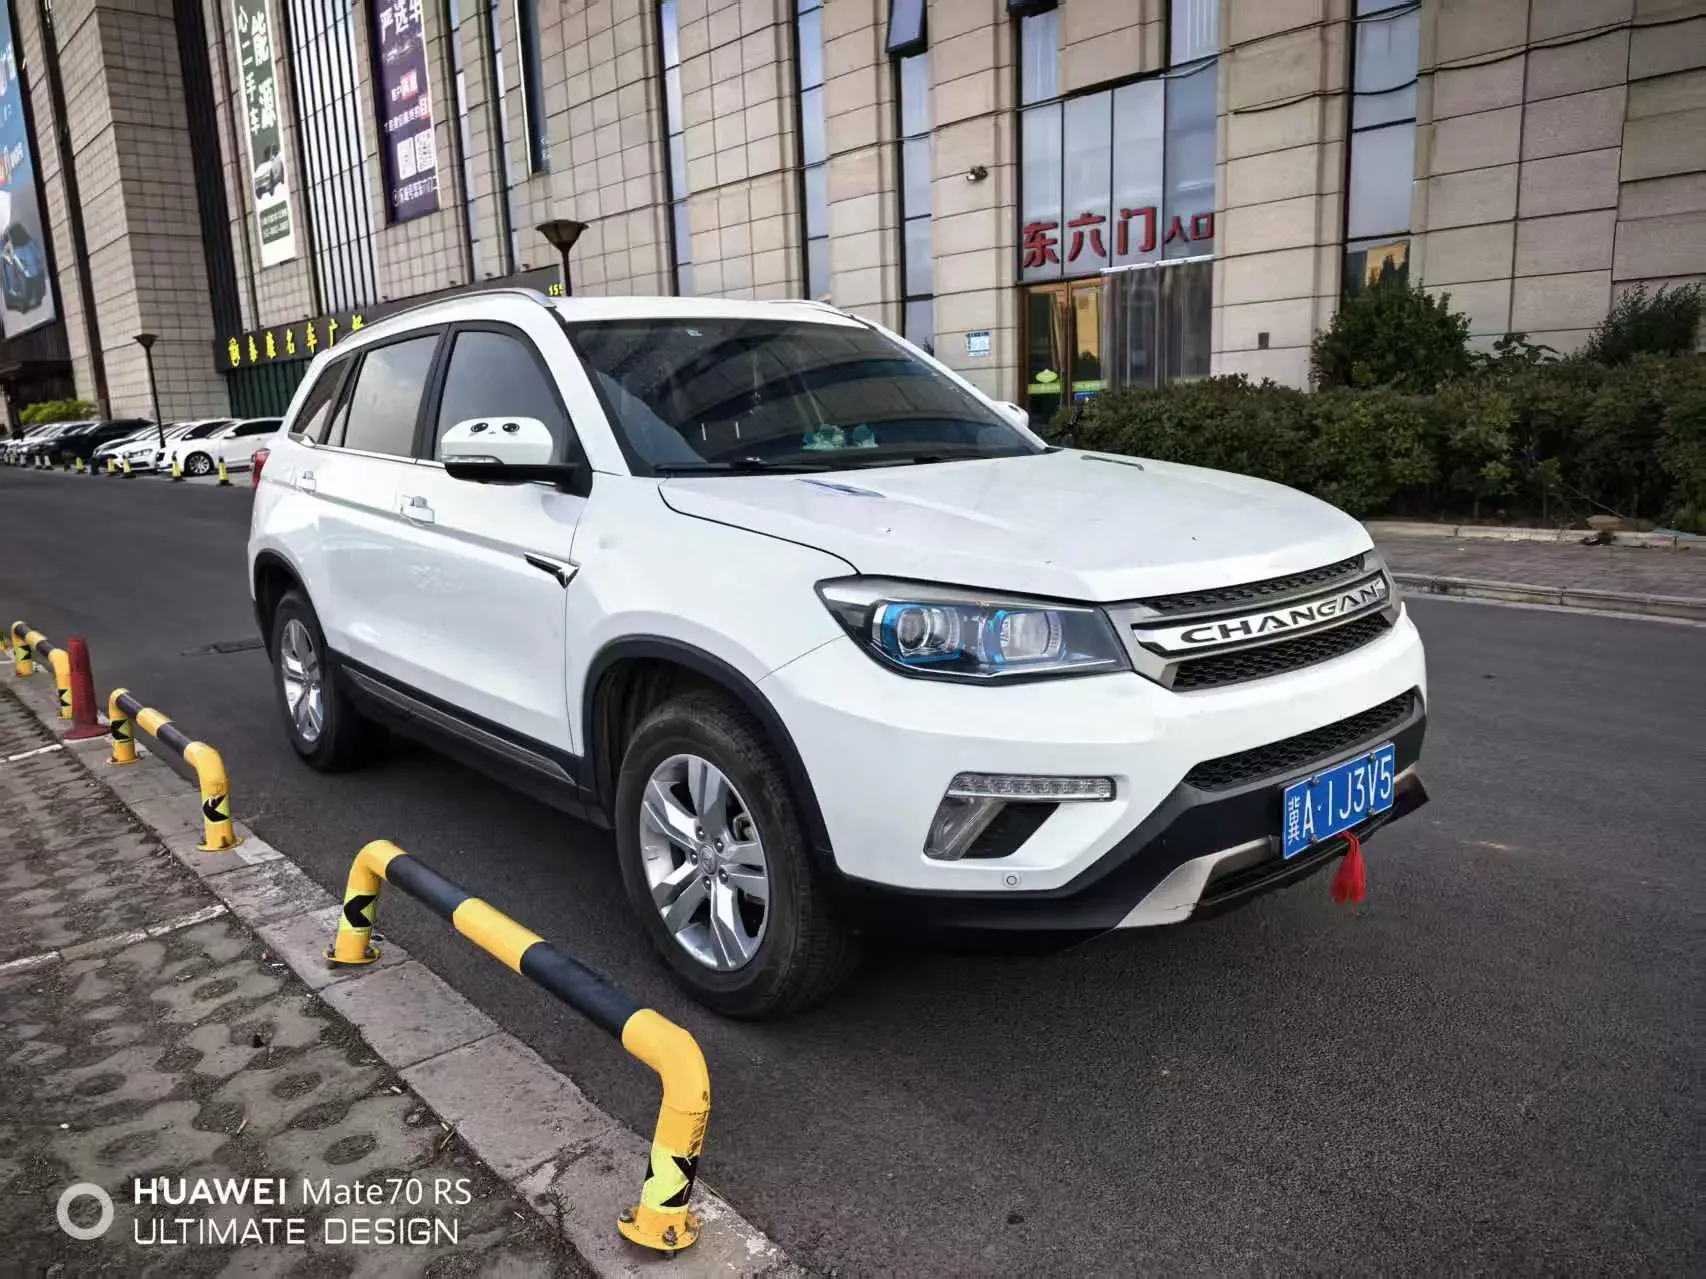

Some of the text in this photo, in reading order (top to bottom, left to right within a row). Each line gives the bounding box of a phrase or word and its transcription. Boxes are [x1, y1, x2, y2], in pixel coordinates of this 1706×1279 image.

[1023, 206, 1215, 268] 东六门入口
[1181, 584, 1378, 644] CHANGAN
